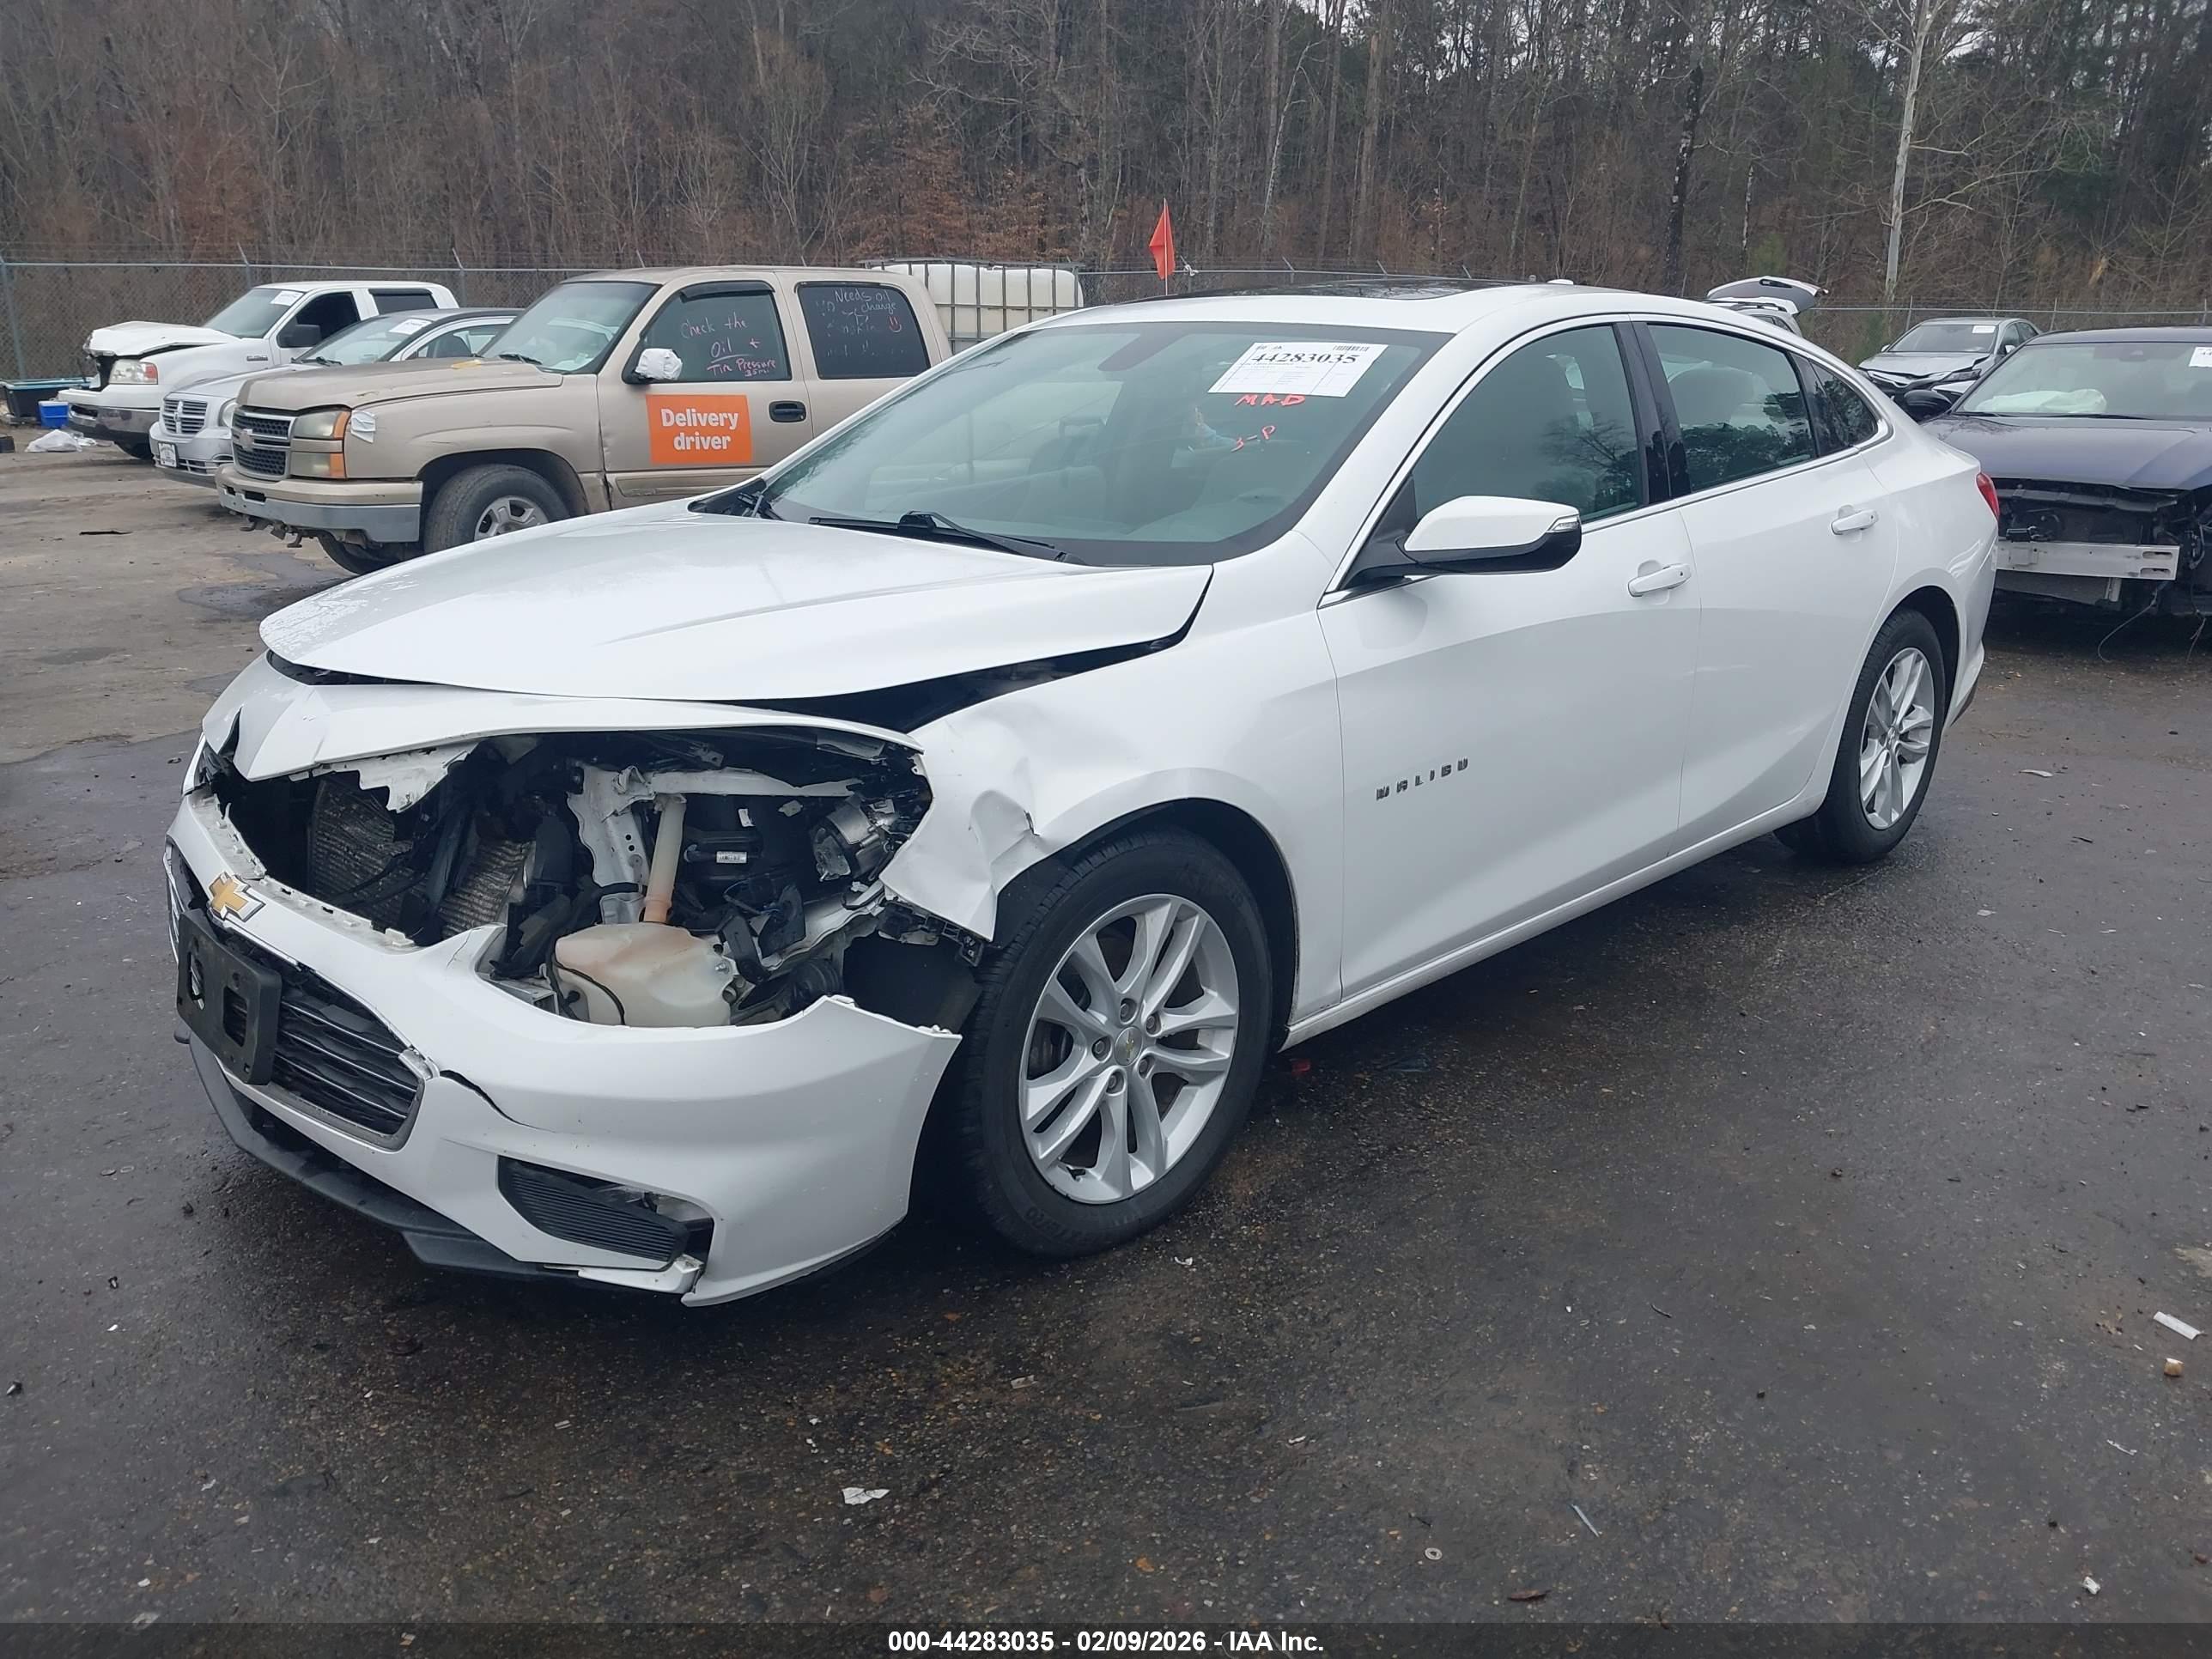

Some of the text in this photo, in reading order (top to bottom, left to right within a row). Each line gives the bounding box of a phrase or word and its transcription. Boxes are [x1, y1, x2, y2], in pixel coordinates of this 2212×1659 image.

[835, 289, 872, 303] Needs
[861, 302, 896, 314] change
[681, 311, 747, 339] Check the
[710, 337, 732, 358] Oil
[736, 357, 776, 372] Pressure
[1251, 352, 1361, 364] 44283035
[660, 408, 738, 430] Delivery
[673, 431, 732, 450] driver
[1376, 757, 1468, 801] MALIBU
